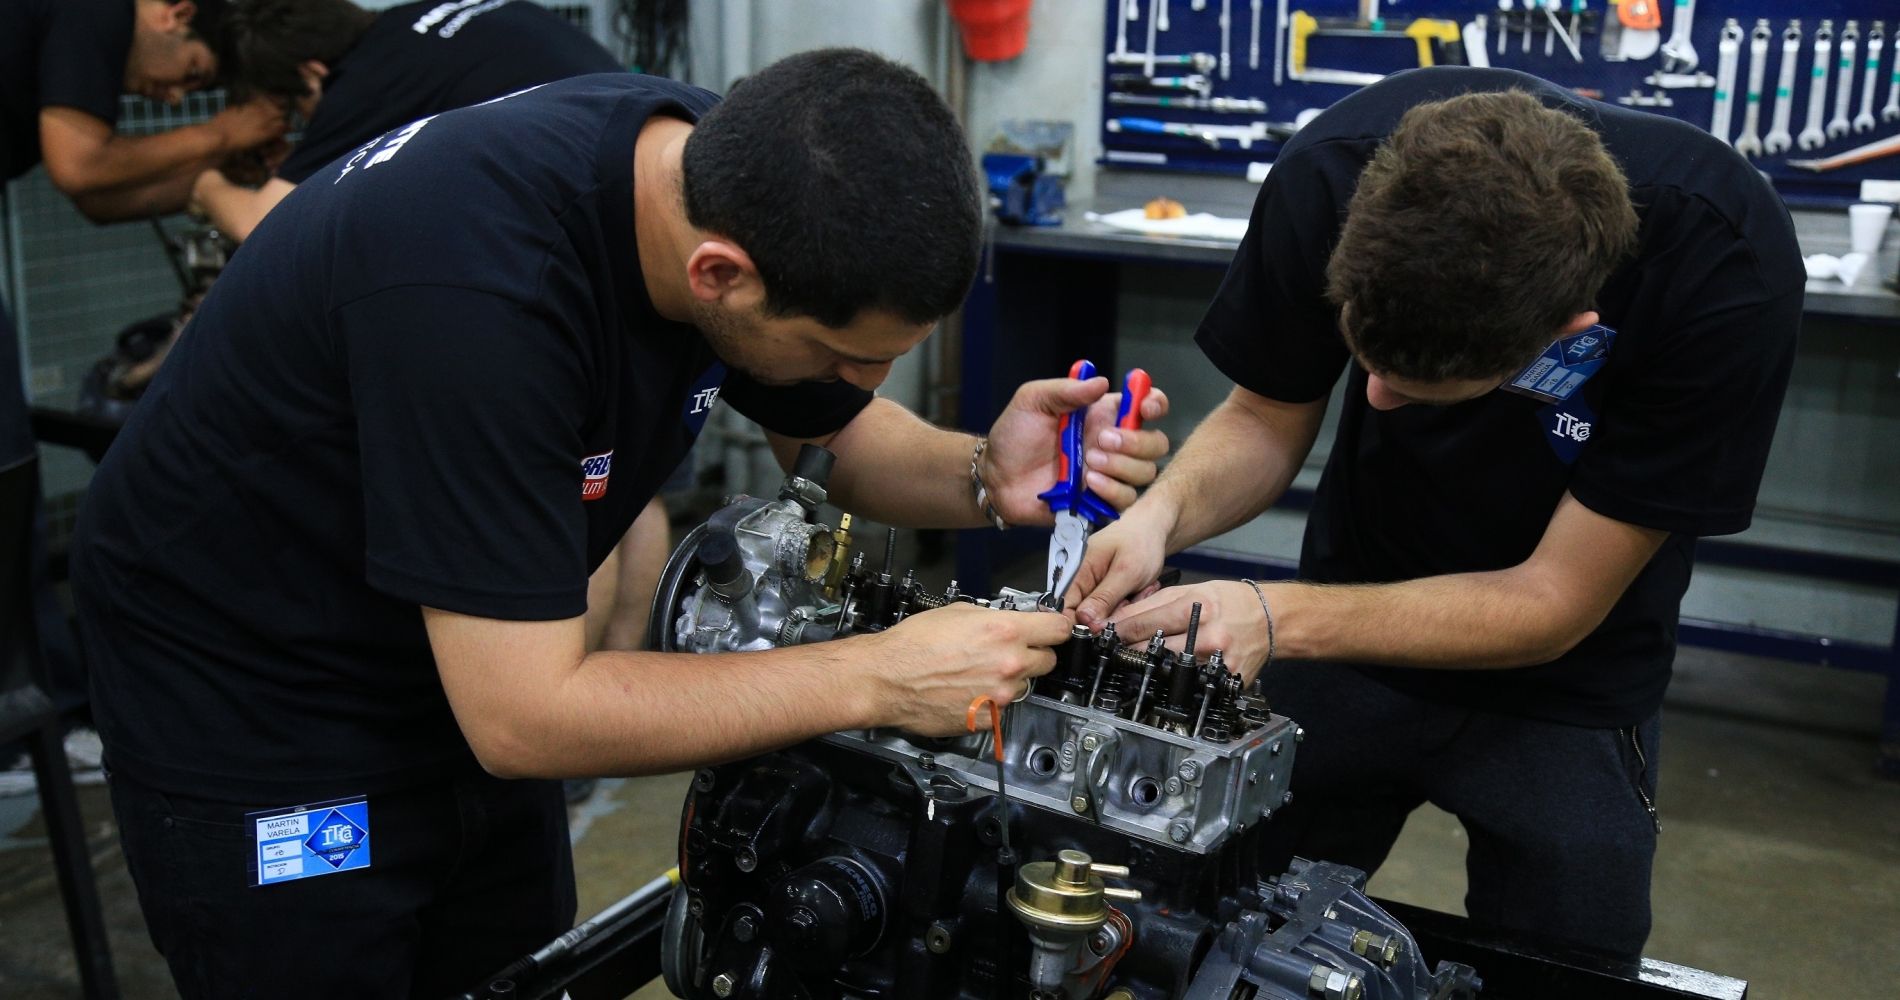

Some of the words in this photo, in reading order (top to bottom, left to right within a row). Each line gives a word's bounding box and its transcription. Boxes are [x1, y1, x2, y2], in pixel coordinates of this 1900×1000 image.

[267, 818, 300, 830] MARTIN
[267, 827, 301, 839] VARELA
[329, 852, 345, 862] 2015
